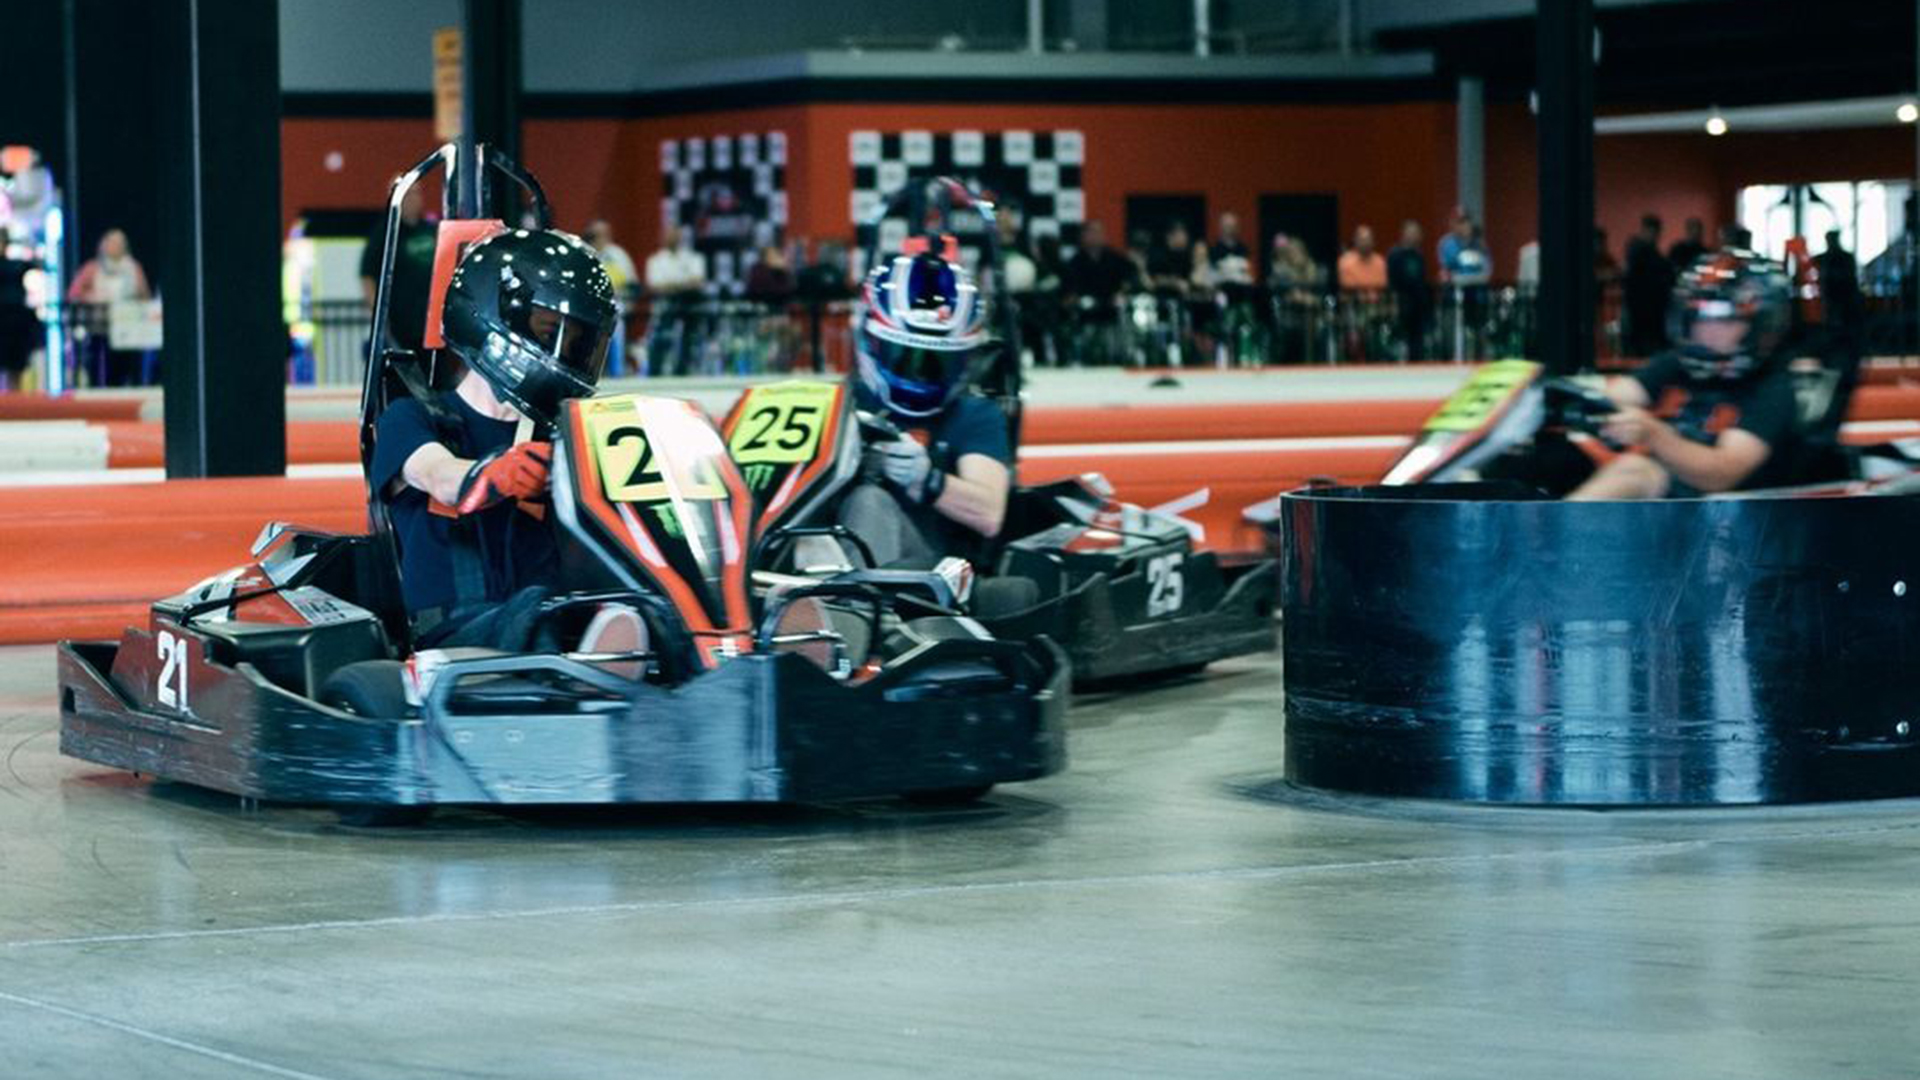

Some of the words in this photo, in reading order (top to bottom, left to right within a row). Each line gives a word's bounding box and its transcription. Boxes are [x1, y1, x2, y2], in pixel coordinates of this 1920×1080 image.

[739, 407, 818, 451] 25
[1147, 553, 1184, 617] 25
[157, 630, 189, 711] 21
